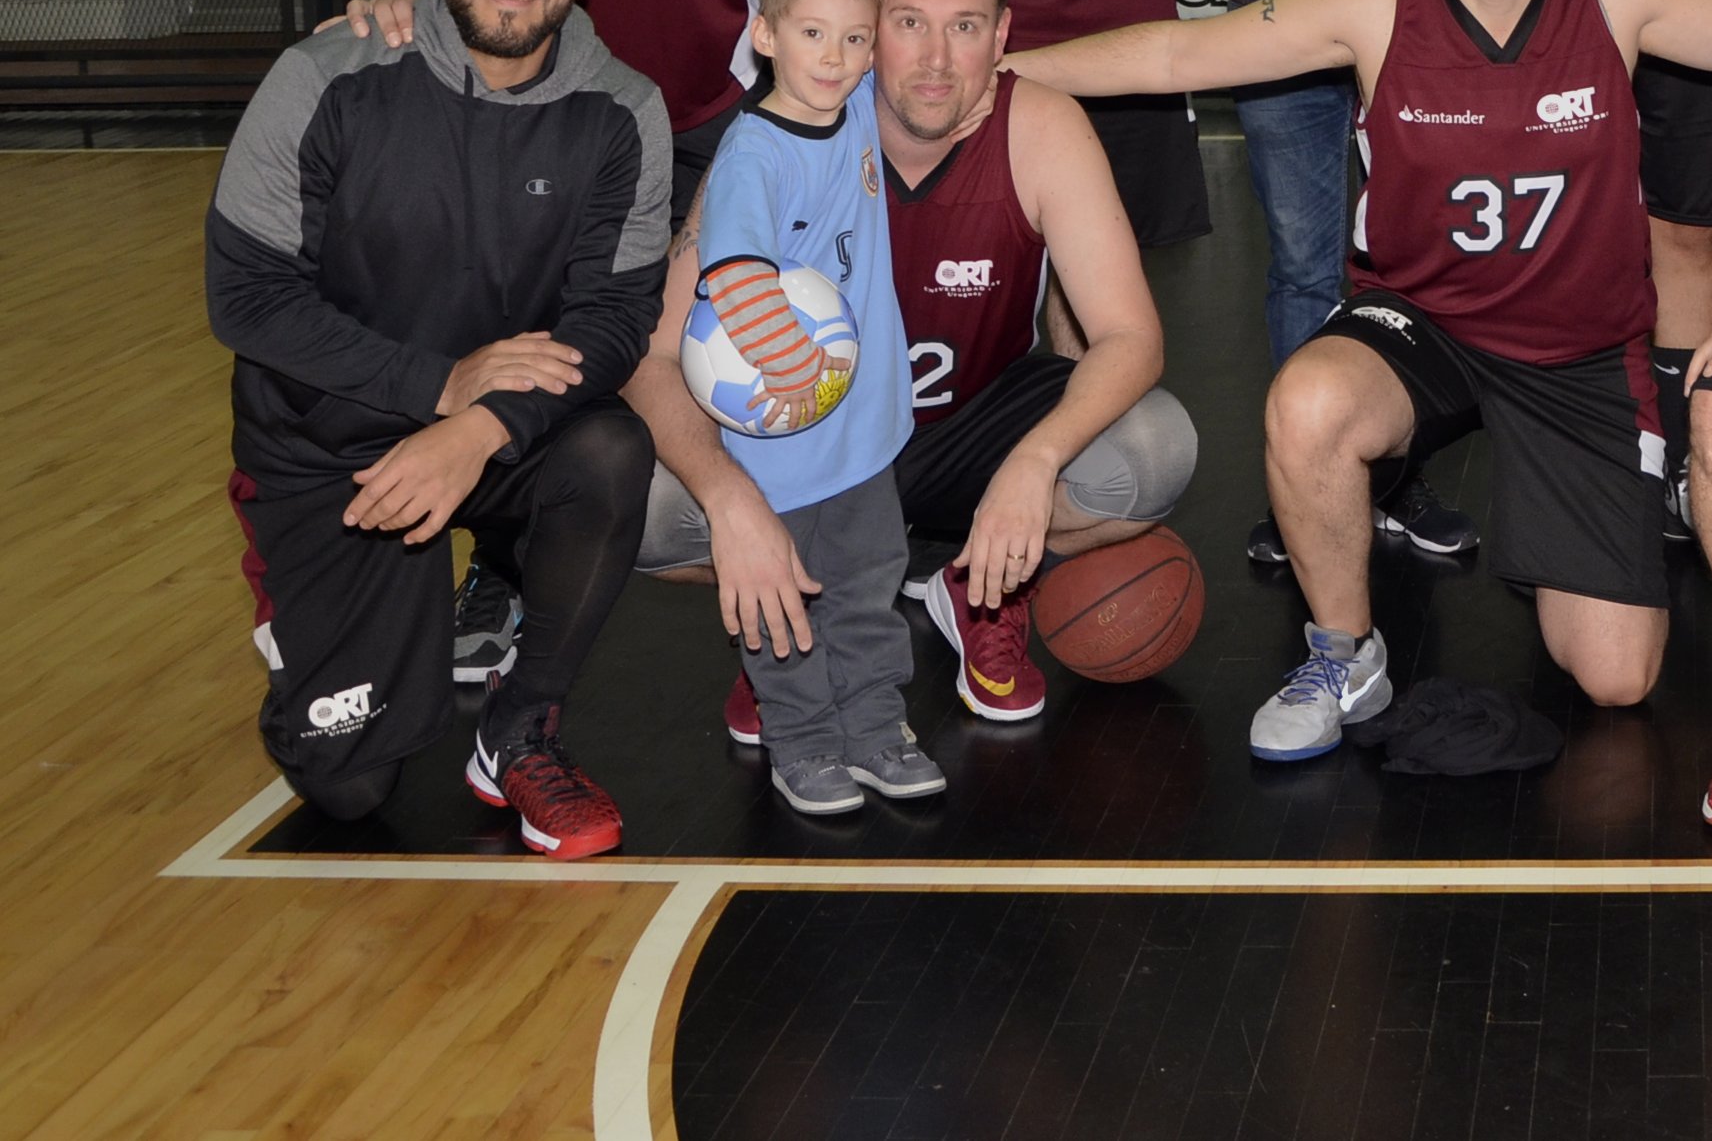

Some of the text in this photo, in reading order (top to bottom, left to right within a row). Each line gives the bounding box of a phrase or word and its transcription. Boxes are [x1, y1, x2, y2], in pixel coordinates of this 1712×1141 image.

[1413, 108, 1486, 125] Santander
[1536, 86, 1596, 124] ORT
[1448, 171, 1568, 253] 37
[935, 259, 993, 287] ORT
[308, 682, 373, 728] ORT
